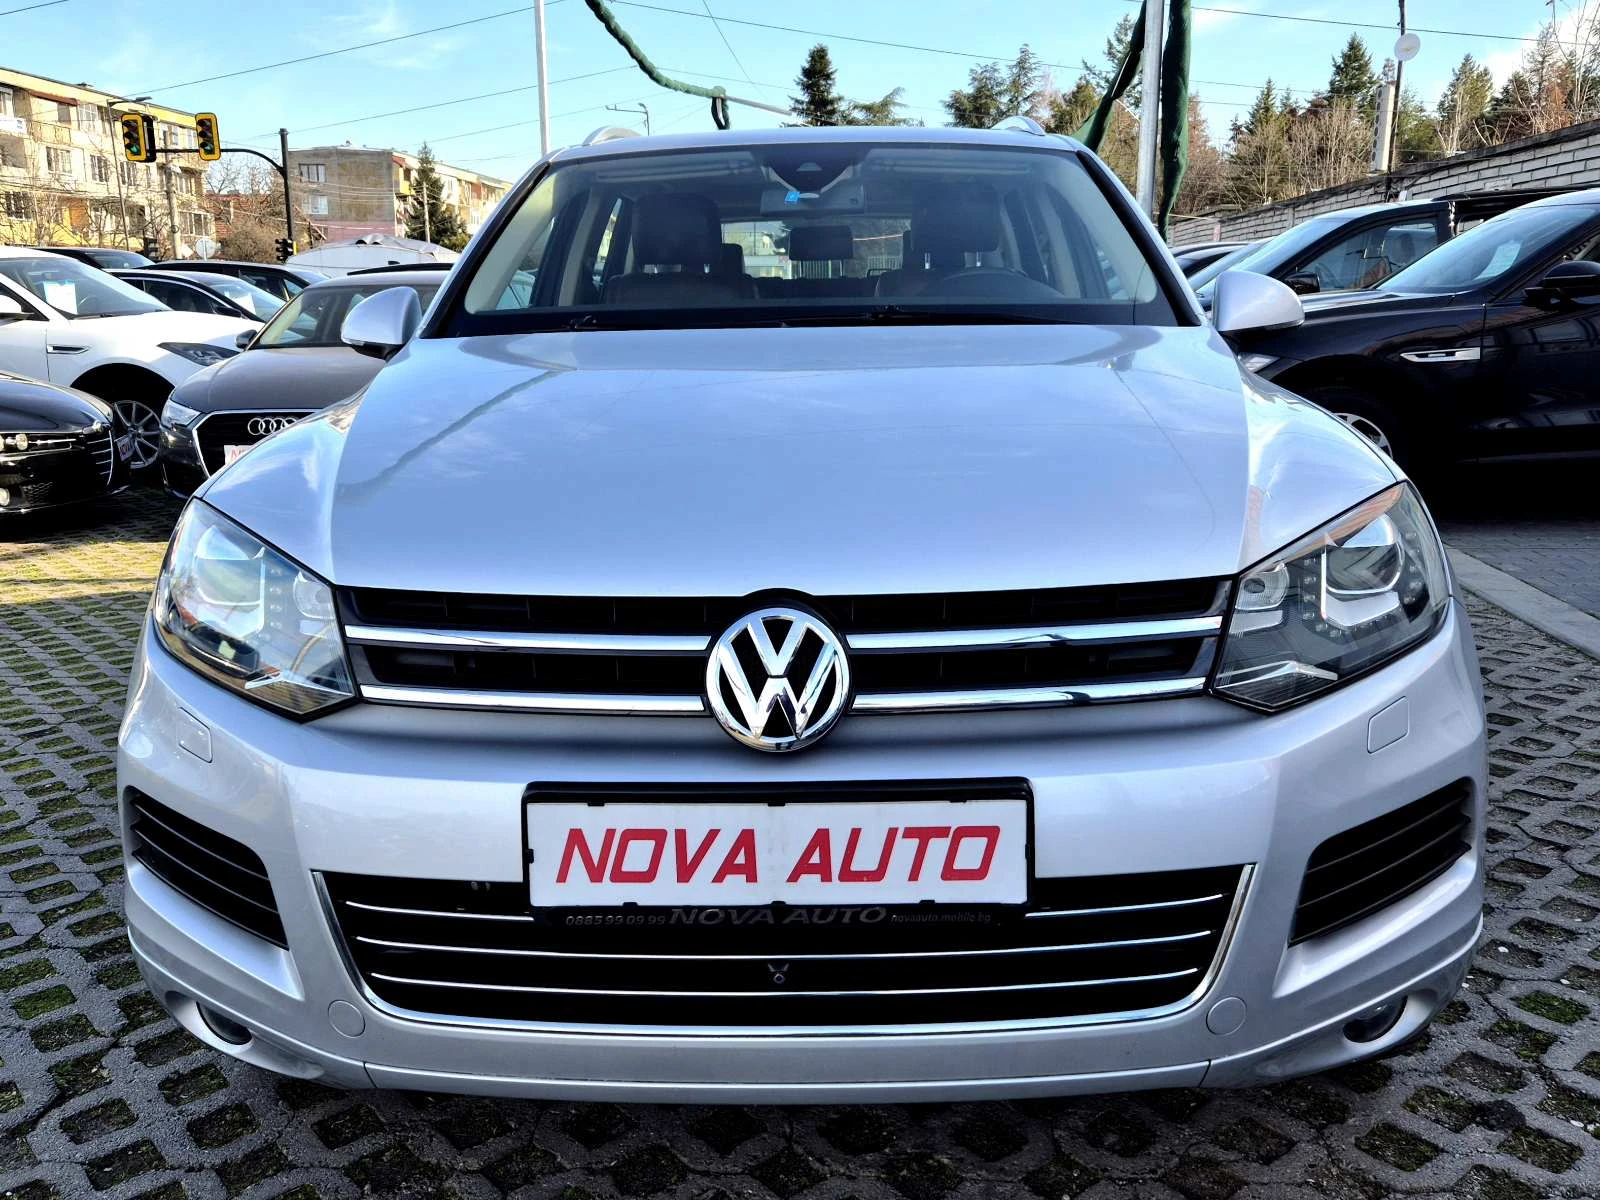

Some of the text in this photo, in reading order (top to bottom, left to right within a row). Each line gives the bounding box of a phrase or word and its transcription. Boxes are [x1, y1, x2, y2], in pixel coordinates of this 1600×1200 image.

[556, 826, 1001, 883] NOVA AUTO
[565, 915, 603, 926] 0885
[668, 906, 888, 925] NOVA AUTO
